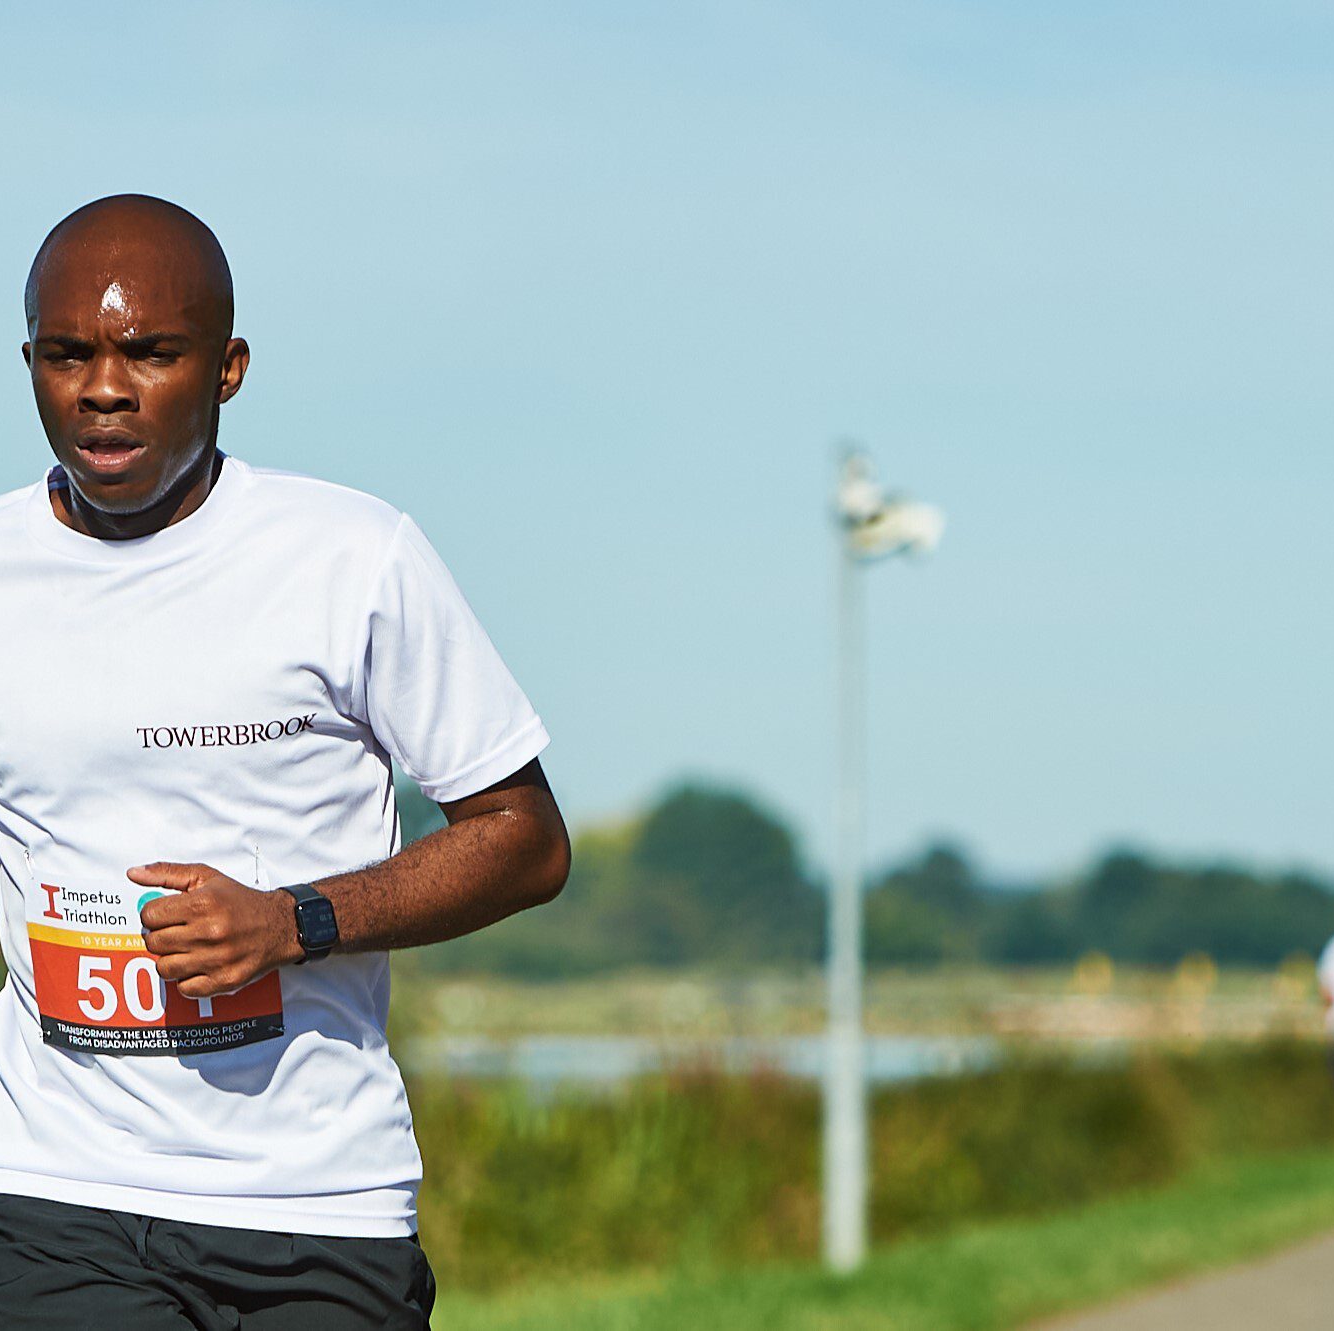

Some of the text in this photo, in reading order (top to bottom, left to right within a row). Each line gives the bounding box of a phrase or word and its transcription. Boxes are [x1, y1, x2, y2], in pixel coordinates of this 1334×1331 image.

[137, 713, 317, 748] TOWERBROOK
[61, 887, 122, 906] Impetus
[63, 907, 127, 925] Triathlon
[80, 936, 91, 946] 10
[93, 936, 122, 947] YEAR
[57, 1019, 257, 1040] TRANSFORMING THE LIVES OF YOUNG PEOPLE
[69, 1032, 244, 1049] FROM DISADVANTAGED BACKGROUNDS
